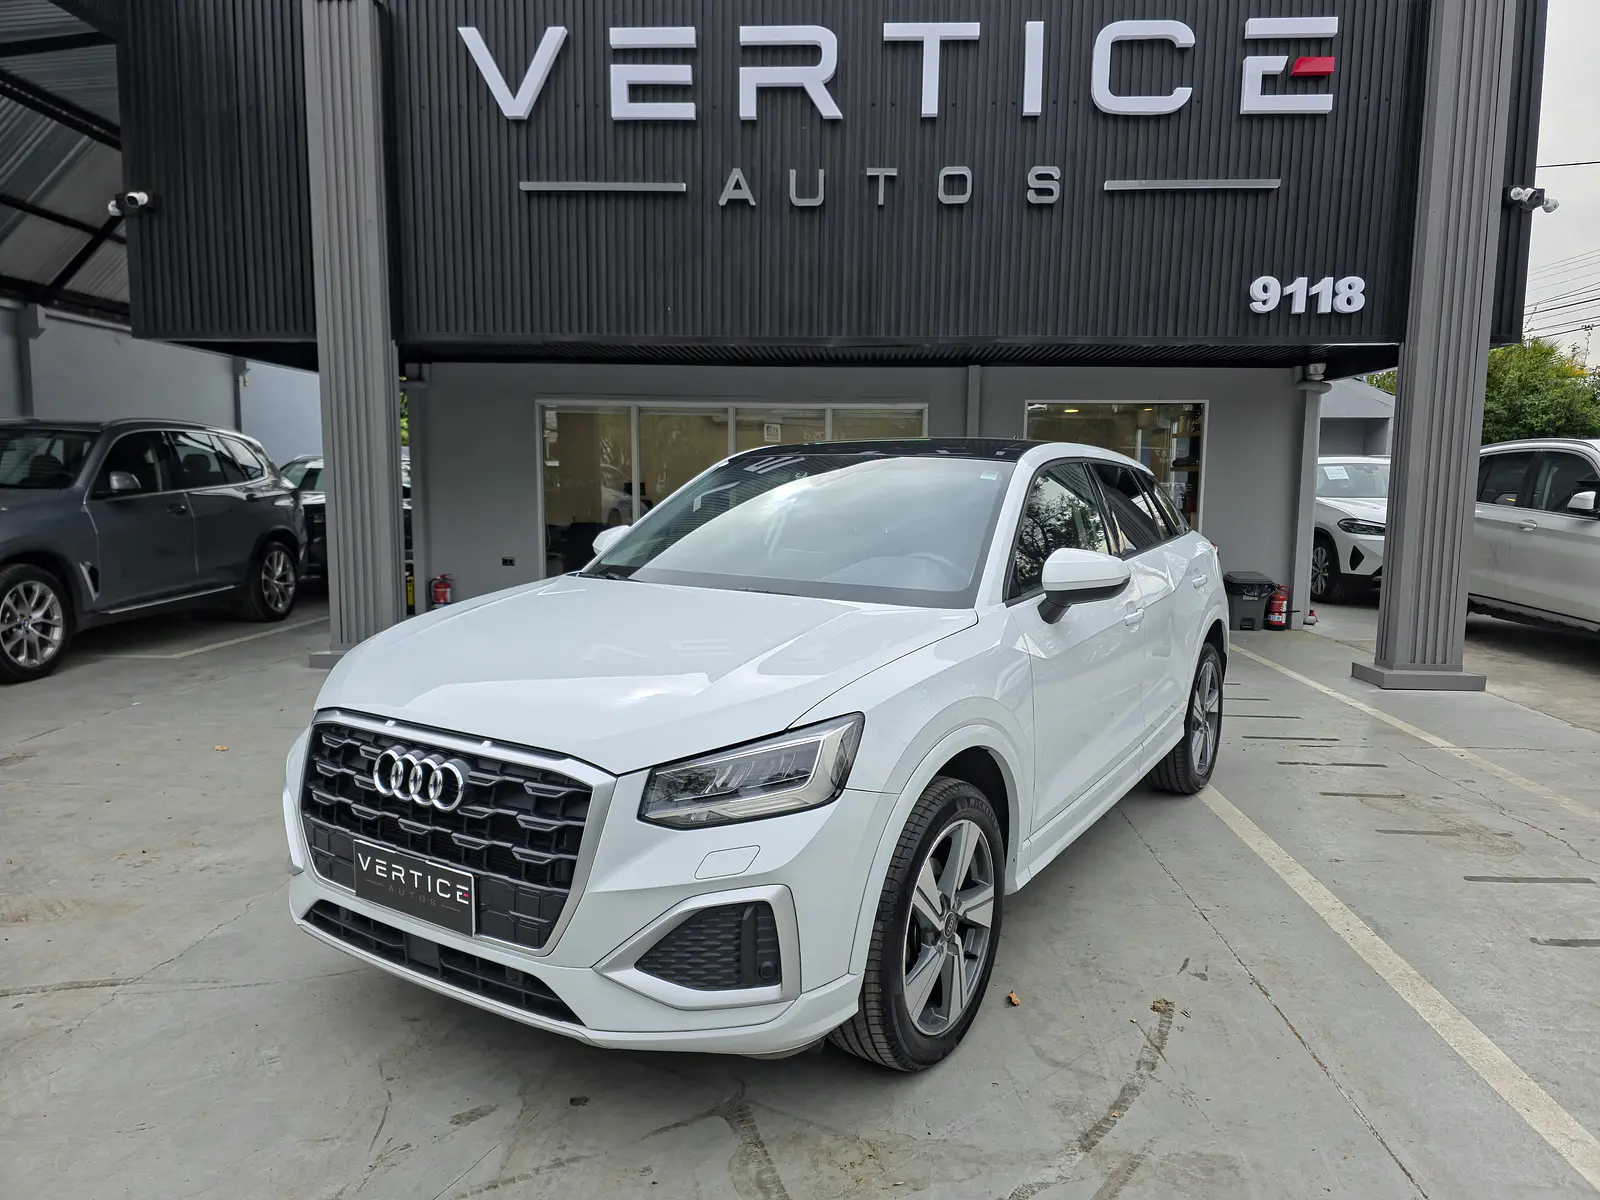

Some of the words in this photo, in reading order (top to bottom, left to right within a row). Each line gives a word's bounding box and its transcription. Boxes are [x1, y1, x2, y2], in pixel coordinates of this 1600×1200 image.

[457, 16, 1339, 121] VERTICE
[717, 165, 1062, 207] AUTOS
[1249, 275, 1366, 315] 9118
[357, 853, 469, 905] VERTICE
[388, 885, 436, 906] AUTOS
